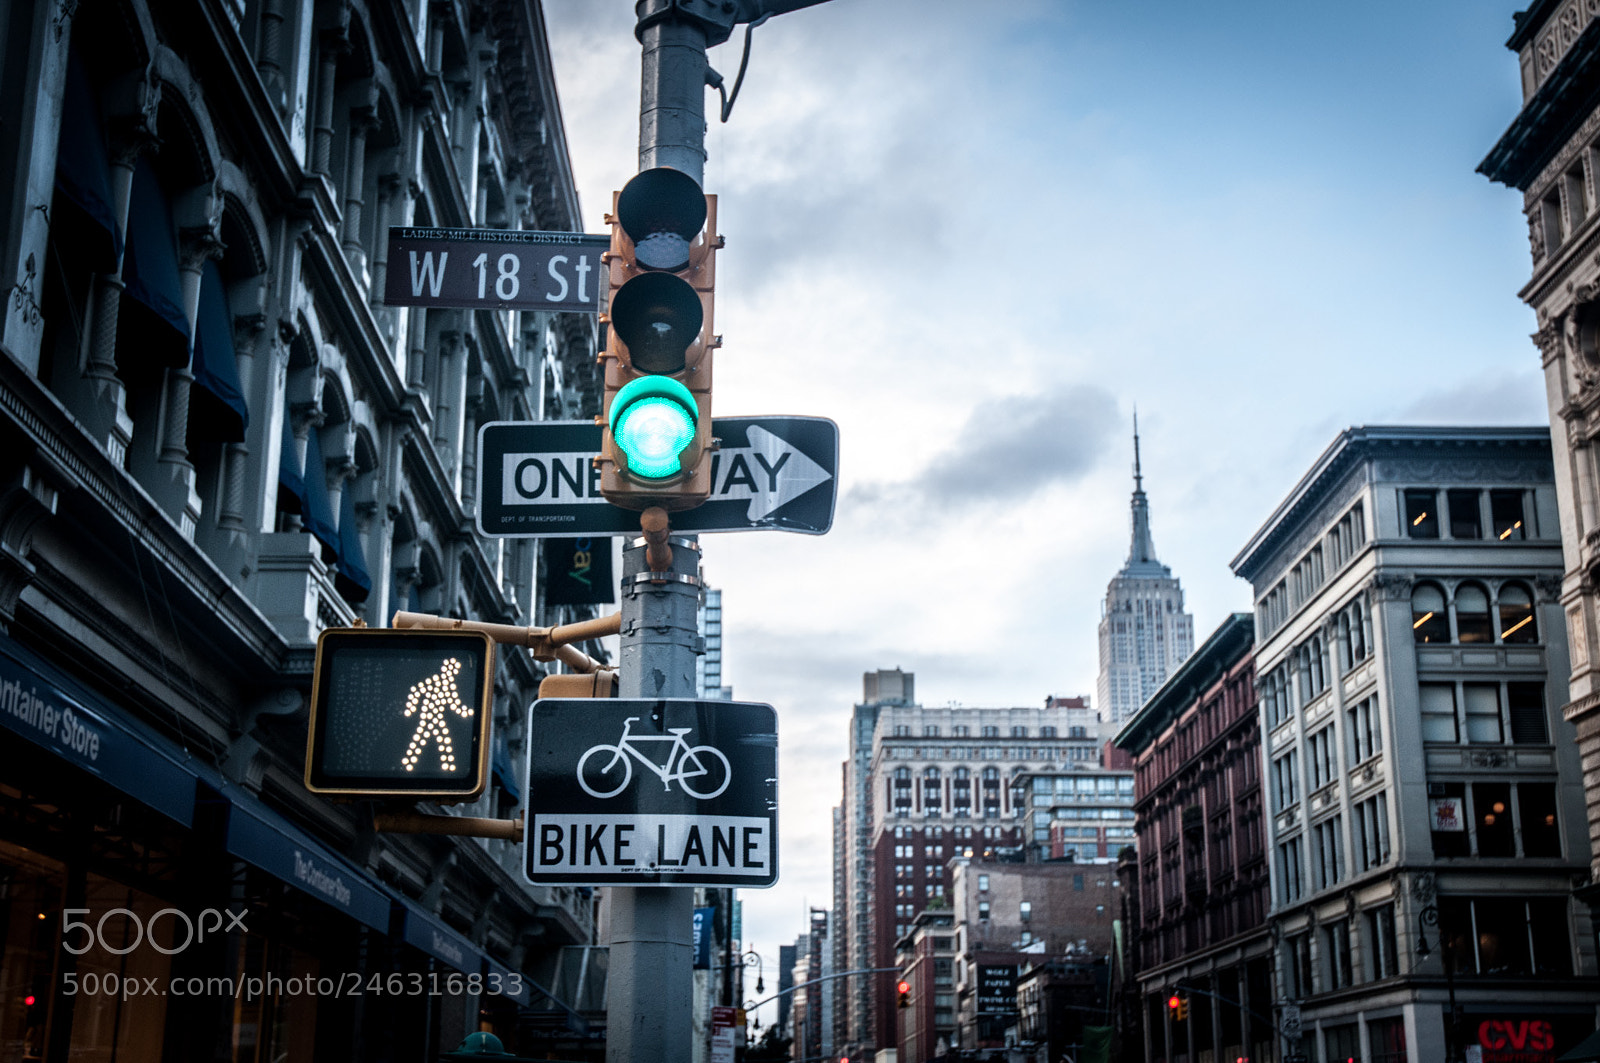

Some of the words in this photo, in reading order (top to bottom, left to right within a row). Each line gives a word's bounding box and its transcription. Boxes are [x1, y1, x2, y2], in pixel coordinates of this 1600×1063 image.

[448, 231, 476, 241] MILE
[478, 232, 530, 243] HISTORIC
[533, 233, 585, 245] DISTRICT
[409, 250, 448, 298] W
[472, 252, 521, 301] 18
[545, 254, 592, 303] St
[0, 676, 62, 739] ntainer
[61, 707, 100, 761] Store
[539, 824, 636, 866] BIKE
[657, 824, 764, 868] LANE
[1478, 1019, 1555, 1051] CVS
